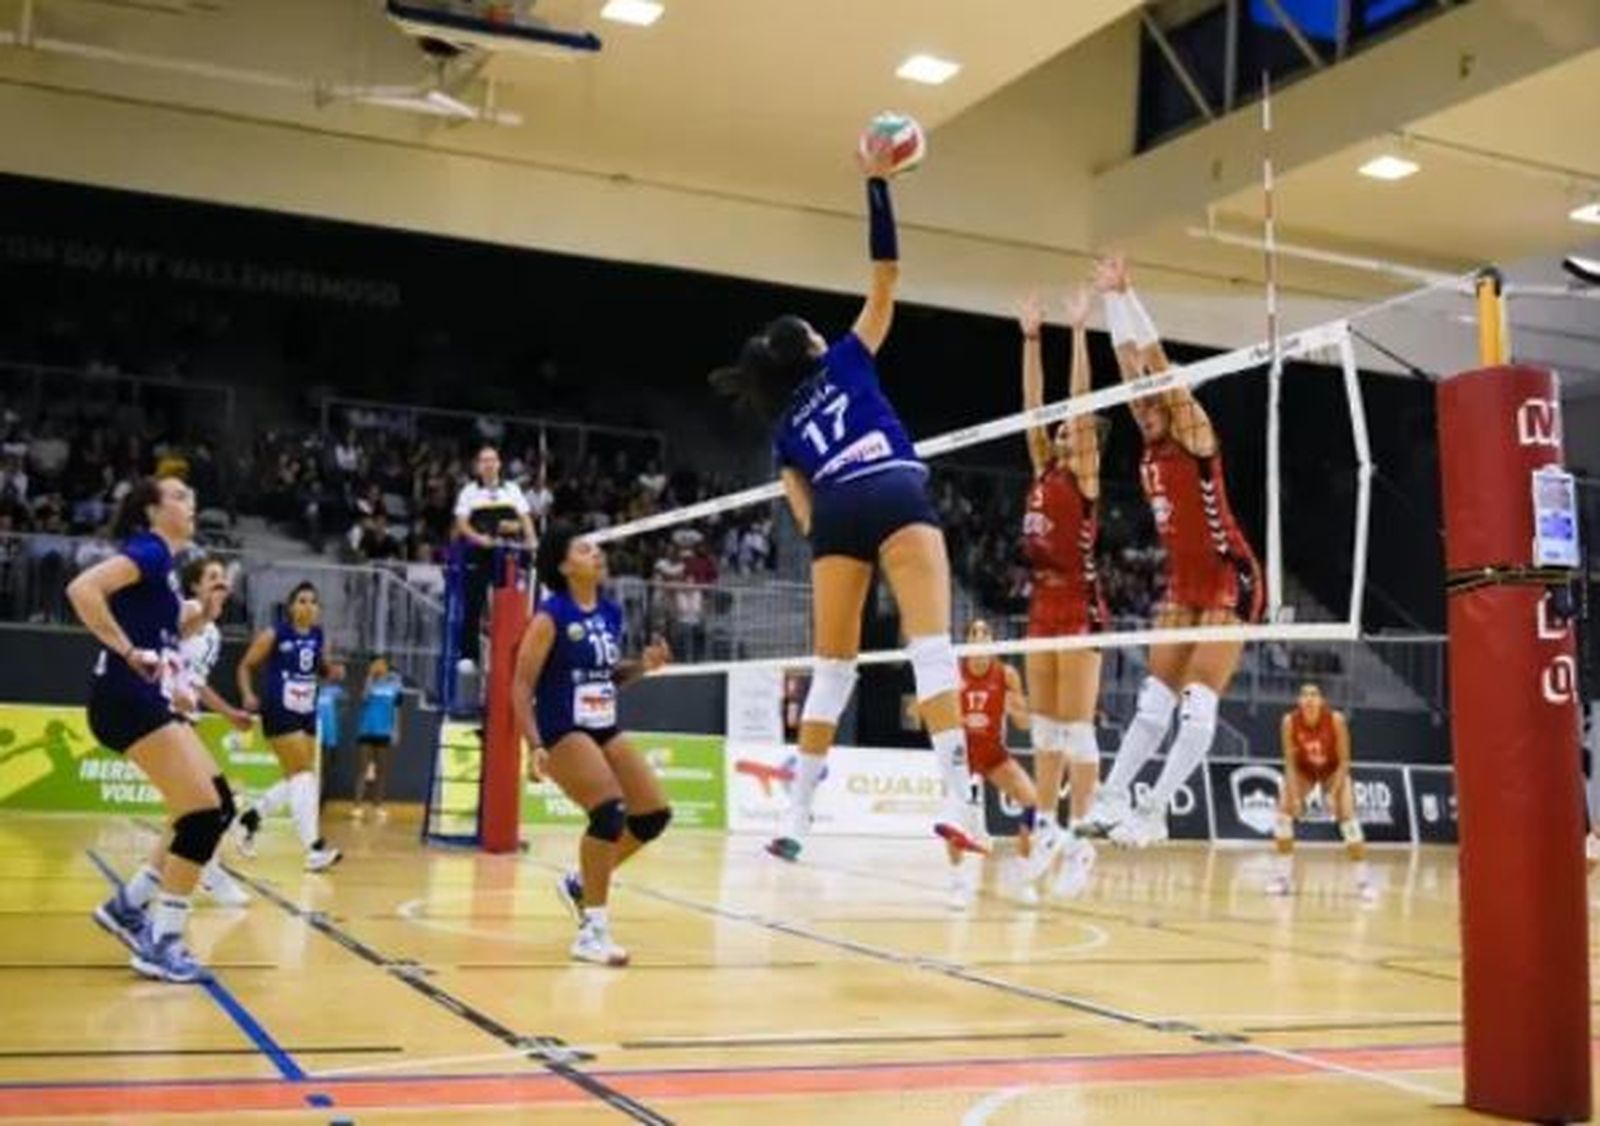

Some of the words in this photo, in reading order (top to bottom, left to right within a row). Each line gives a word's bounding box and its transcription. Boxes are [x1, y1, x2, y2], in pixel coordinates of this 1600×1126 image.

[801, 393, 848, 455] 17
[299, 647, 315, 673] 8
[588, 631, 621, 666] 16
[966, 690, 989, 711] 17
[846, 773, 948, 797] QUART
